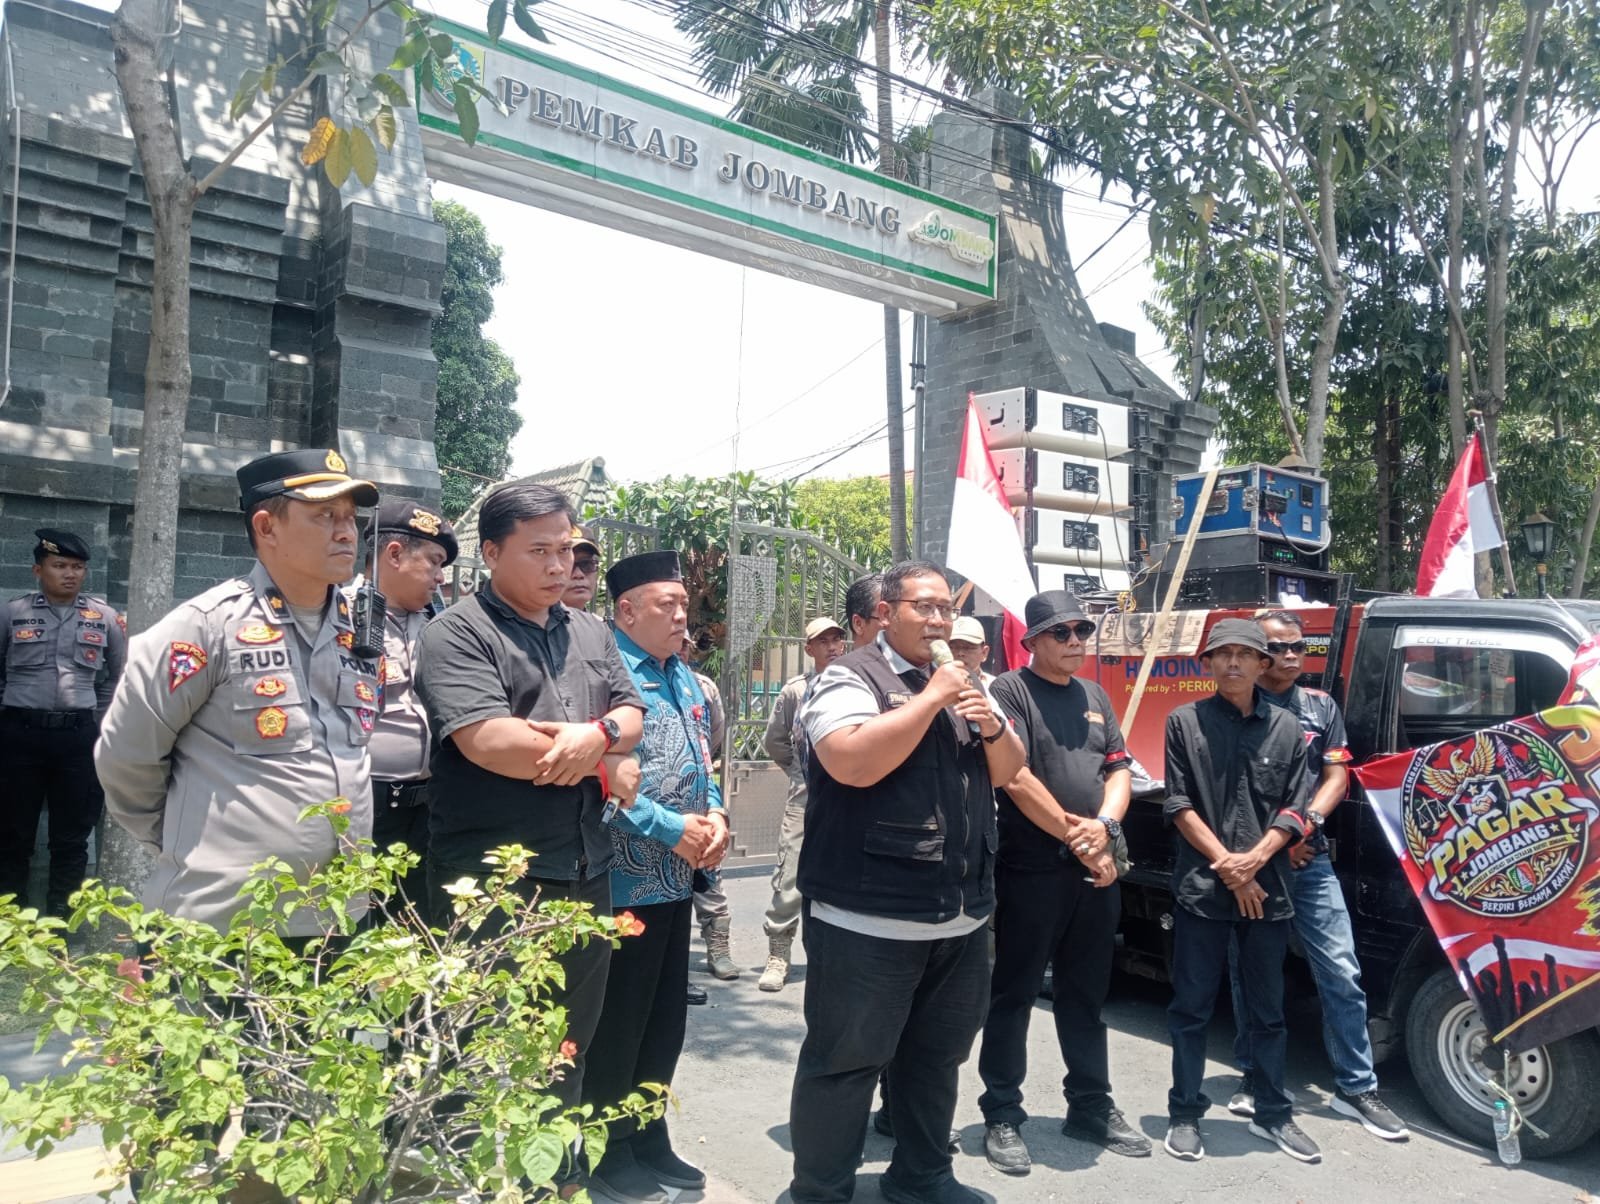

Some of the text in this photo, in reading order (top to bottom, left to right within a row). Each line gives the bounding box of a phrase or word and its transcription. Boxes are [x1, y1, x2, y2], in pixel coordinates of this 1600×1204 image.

[501, 75, 900, 234] PEMKAB JOMBANG
[1416, 636, 1451, 645] COLT
[240, 651, 292, 669] RUDI
[340, 655, 377, 677] POLRI
[1126, 658, 1213, 678] HMOIN
[1405, 757, 1424, 793] LEMBAGA
[1431, 786, 1582, 885] PAGAR
[1468, 823, 1550, 877] JOMBANG
[1481, 860, 1576, 912] BERDIRI BERSAMA RAKYAT
